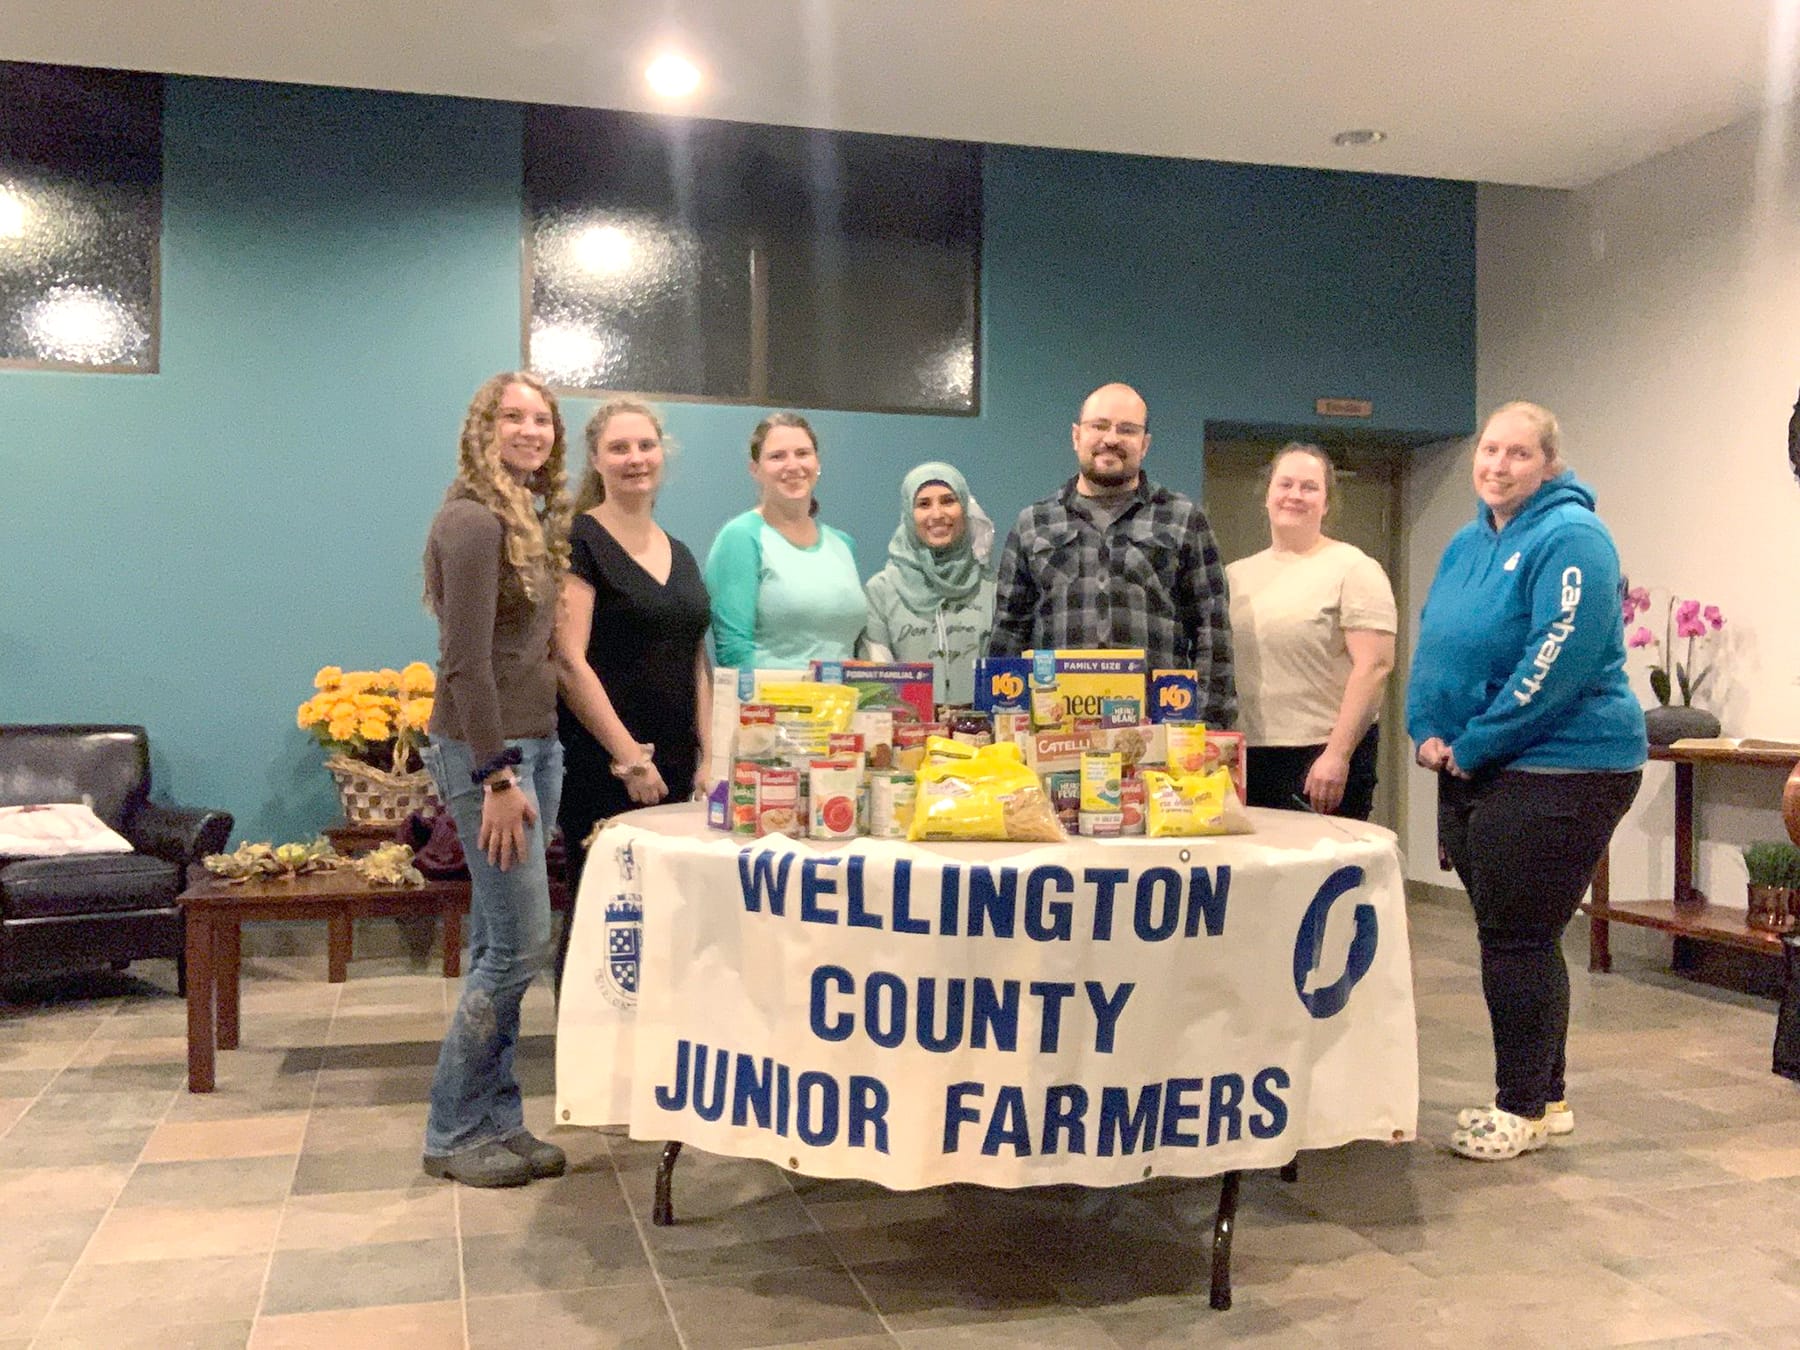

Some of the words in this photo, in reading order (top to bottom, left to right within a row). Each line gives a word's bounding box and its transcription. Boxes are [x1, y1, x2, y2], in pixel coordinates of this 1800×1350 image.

[1063, 661, 1098, 670] FAMILY
[1101, 662, 1121, 670] SIZE
[1039, 739, 1090, 754] CATELLI
[737, 848, 1231, 942] WELLINGTON
[810, 965, 1136, 1054] COUNTY
[655, 1039, 889, 1155] JUNIOR
[943, 1067, 1289, 1157] FARMERS
